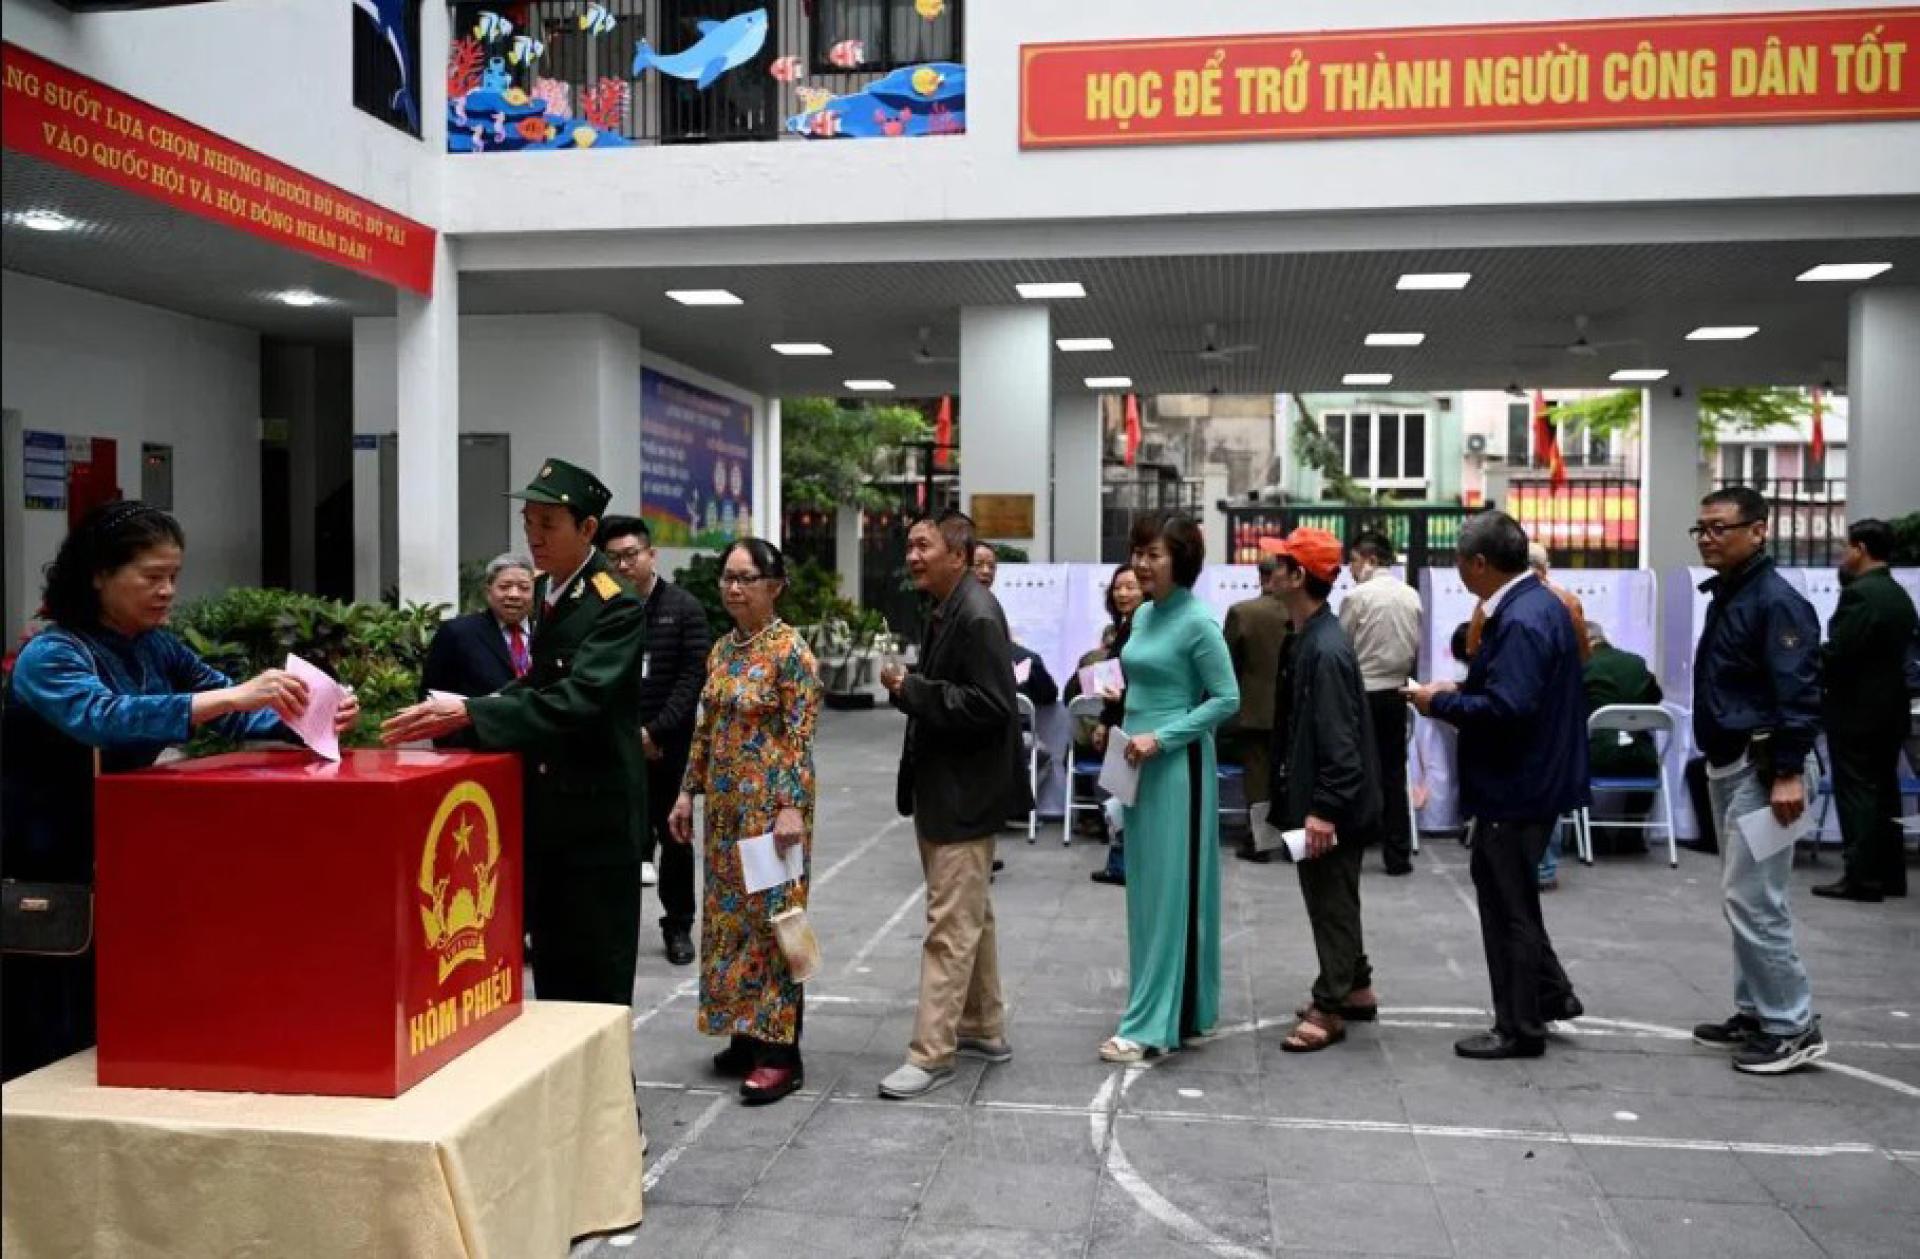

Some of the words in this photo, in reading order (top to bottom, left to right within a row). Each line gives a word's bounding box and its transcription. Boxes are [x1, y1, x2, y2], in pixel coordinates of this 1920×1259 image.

[3, 65, 39, 98] NG
[44, 82, 102, 122] SUỐT
[106, 107, 144, 140] LỰA
[149, 126, 200, 162] CHỌN
[1086, 71, 1162, 130] HỌC
[1173, 48, 1226, 117] ĐỂ
[1234, 48, 1310, 115] TRỞ
[1320, 51, 1451, 112] THÀNH
[1463, 42, 1589, 107] NGƯỜI
[1603, 40, 1716, 101] CÔNG
[1731, 36, 1818, 97] DÂN
[1831, 25, 1907, 93] TỐT
[42, 121, 88, 157] VÀO
[92, 143, 149, 180] QUỐC
[152, 164, 185, 194] HỘI
[190, 178, 213, 204] VÀ
[409, 997, 457, 1056] HÒM
[462, 957, 512, 1027] PHIẾU
